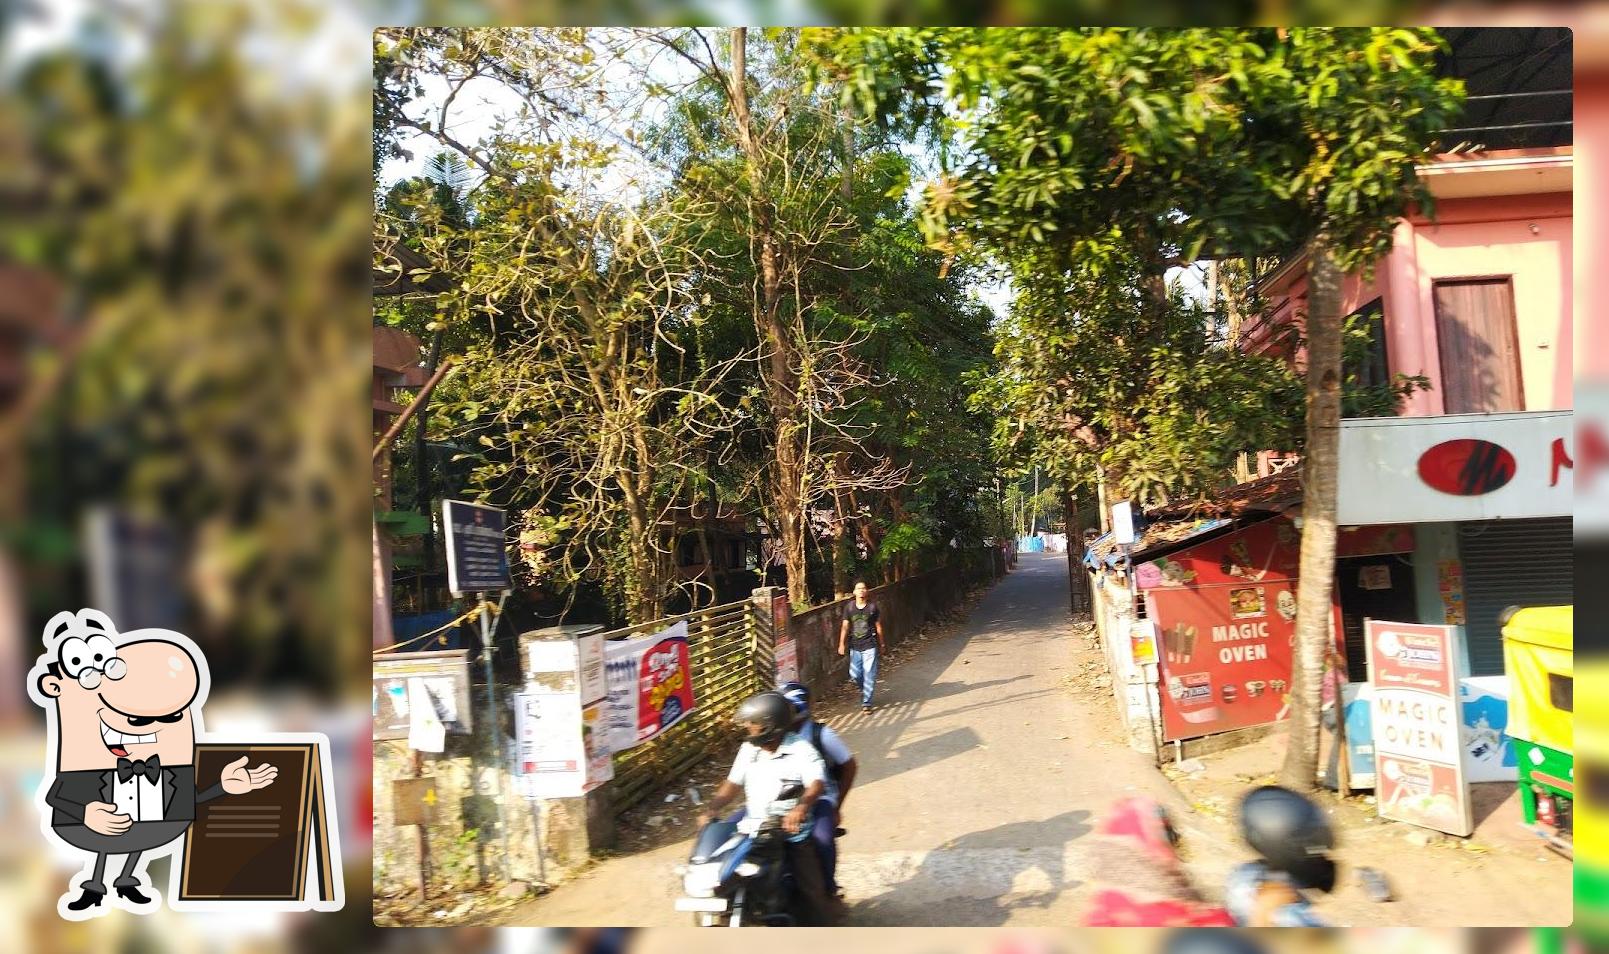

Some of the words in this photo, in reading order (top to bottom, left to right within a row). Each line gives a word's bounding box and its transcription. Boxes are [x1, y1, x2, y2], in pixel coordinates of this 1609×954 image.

[1212, 622, 1269, 642] MAGIC
[1219, 644, 1268, 664] OVEN
[1379, 697, 1447, 724] MAGIC
[1385, 725, 1443, 751] OVEN
